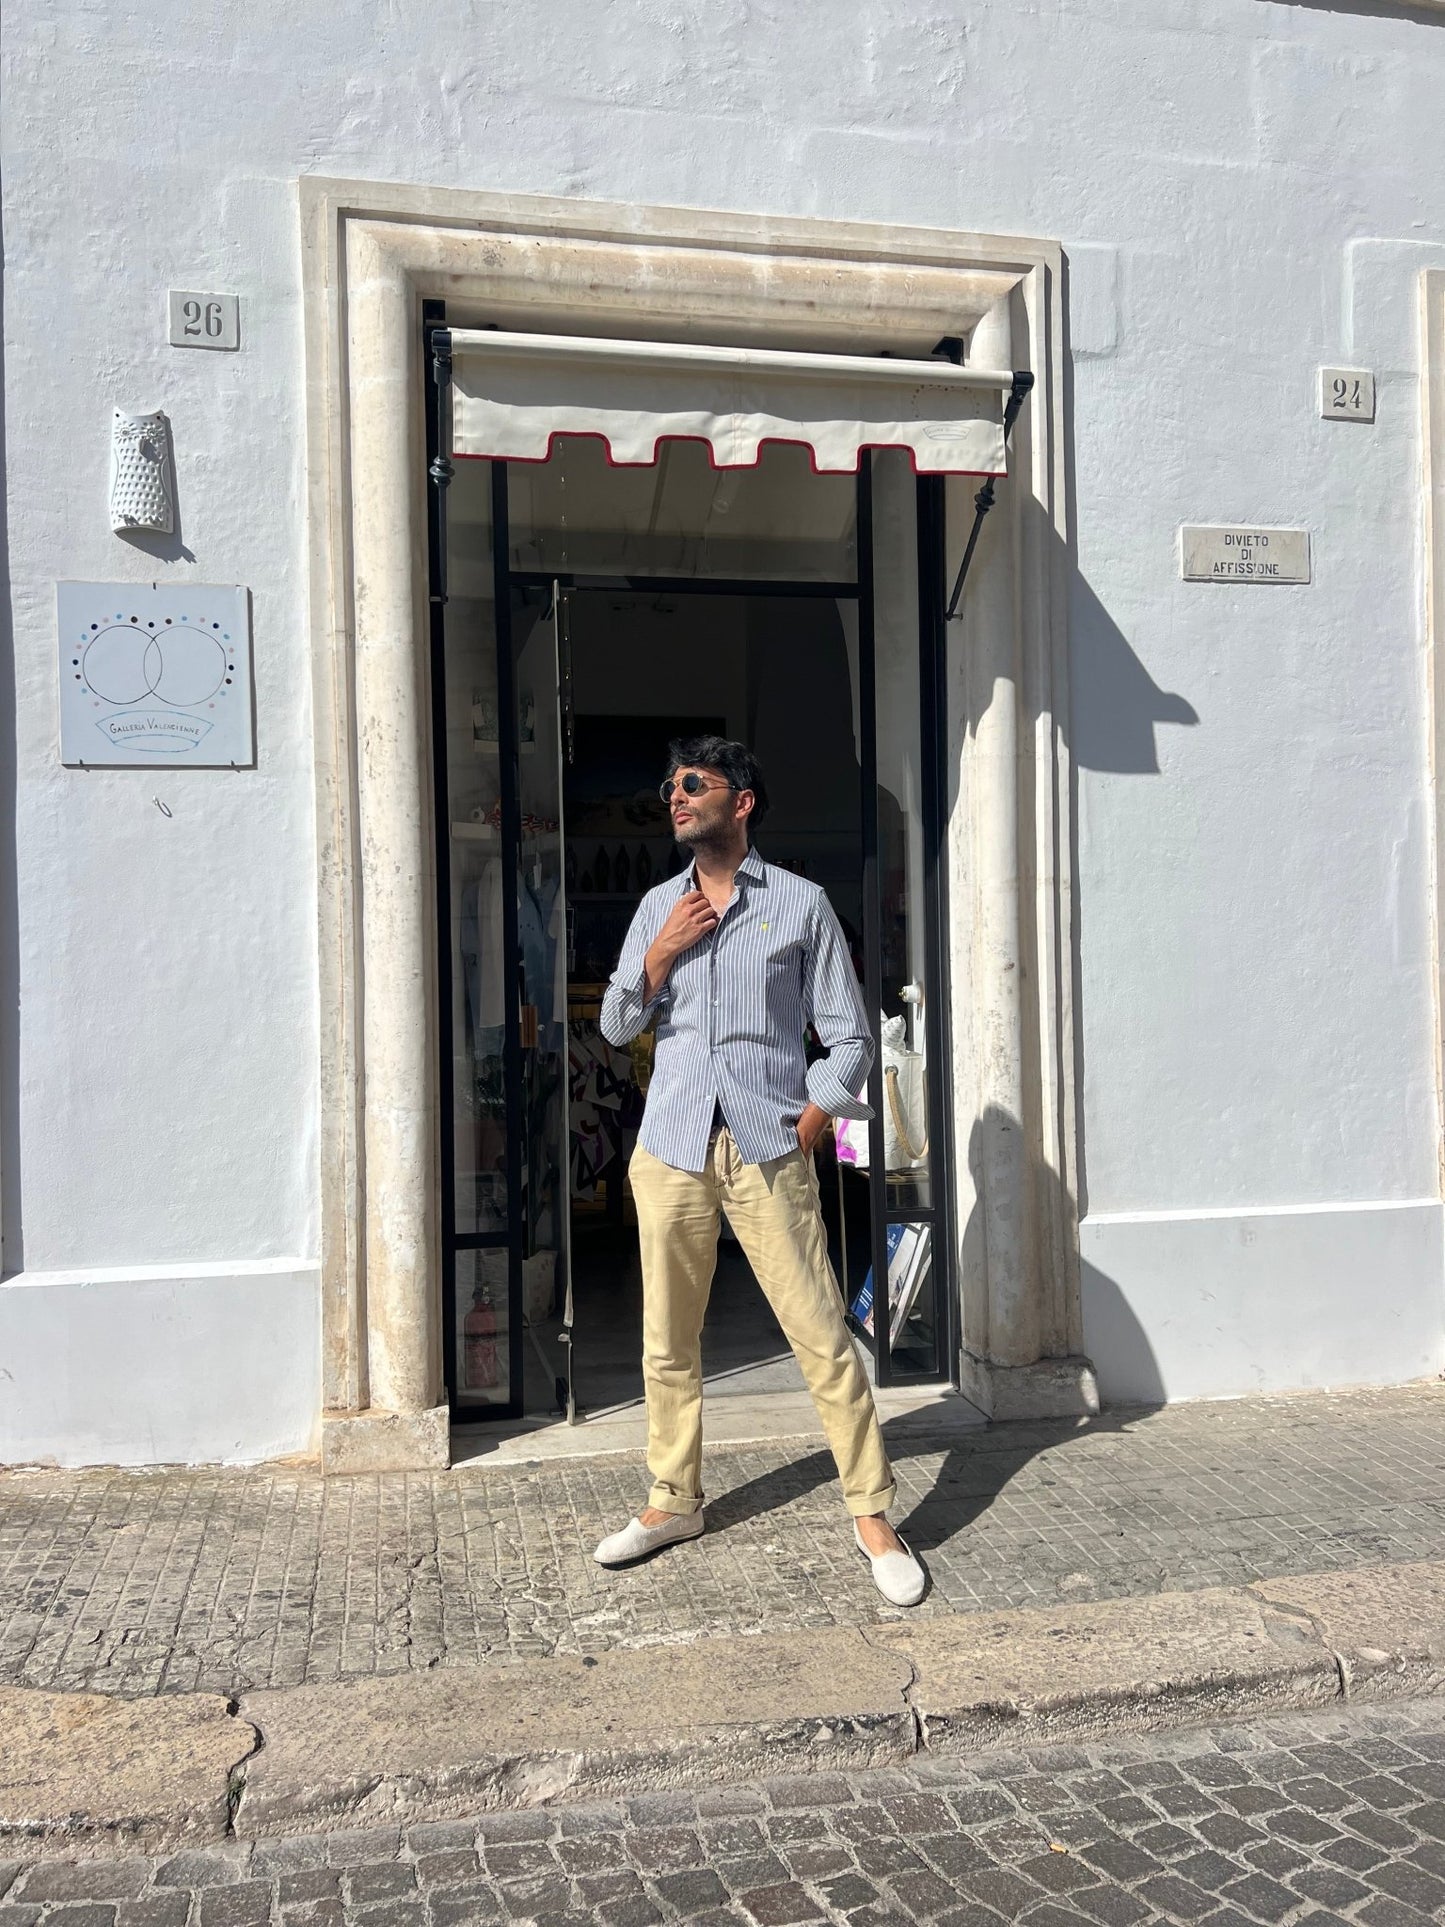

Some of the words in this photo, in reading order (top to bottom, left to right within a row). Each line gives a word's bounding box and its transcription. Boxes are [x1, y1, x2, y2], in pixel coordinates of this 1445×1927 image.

[183, 300, 223, 337] 26
[1333, 378, 1362, 409] 24
[1224, 534, 1269, 547] DIVIETO
[1241, 548, 1252, 561] DI
[1213, 561, 1280, 575] AFFISSIONE
[109, 722, 146, 734] GALLERIA
